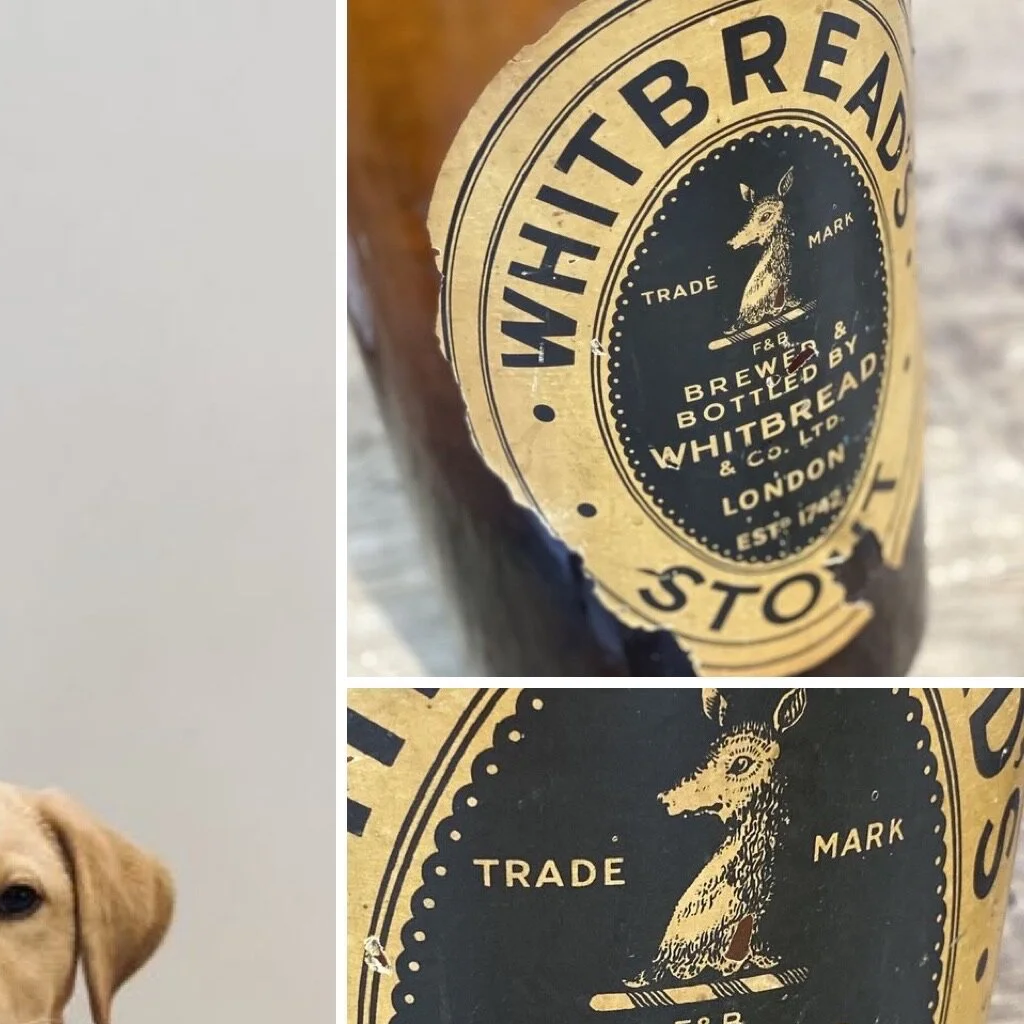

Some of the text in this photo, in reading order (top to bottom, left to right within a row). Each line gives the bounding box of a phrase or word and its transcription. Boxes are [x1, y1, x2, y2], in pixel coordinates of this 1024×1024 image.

[807, 212, 855, 248] MARK
[641, 275, 719, 305] TRADE
[834, 321, 847, 340] &
[677, 334, 858, 429] BOTTLED BY
[649, 352, 877, 470] WHITBREAD
[719, 459, 736, 477] &
[722, 443, 846, 516] LONDON
[797, 486, 844, 526] 1742
[637, 462, 896, 631] STOT
[813, 818, 905, 862] MARK
[474, 859, 626, 887] TRADE
